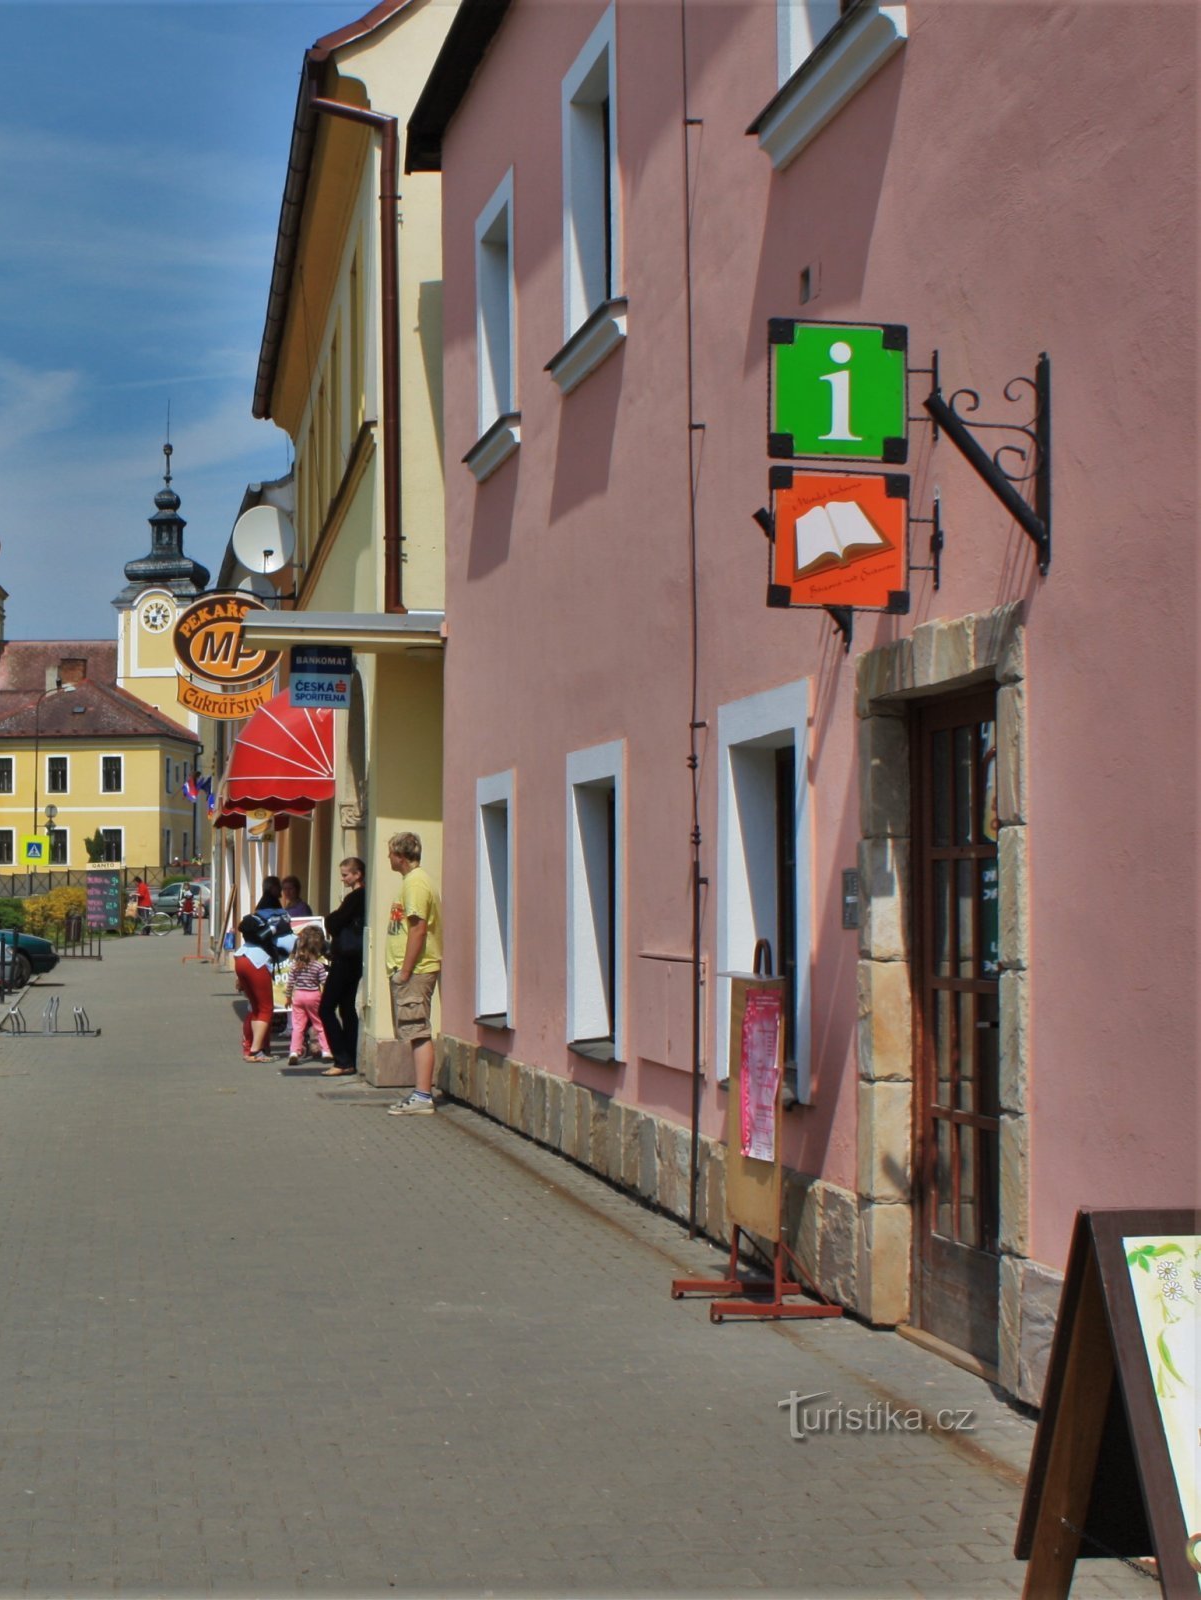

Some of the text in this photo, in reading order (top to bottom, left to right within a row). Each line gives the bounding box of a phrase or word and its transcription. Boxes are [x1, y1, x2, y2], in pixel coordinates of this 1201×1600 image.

[179, 599, 251, 638] PEKAŘS
[295, 656, 347, 665] BANKOMAT
[295, 680, 334, 692] ČESKÁ
[295, 692, 346, 702] SPOŘITELNA
